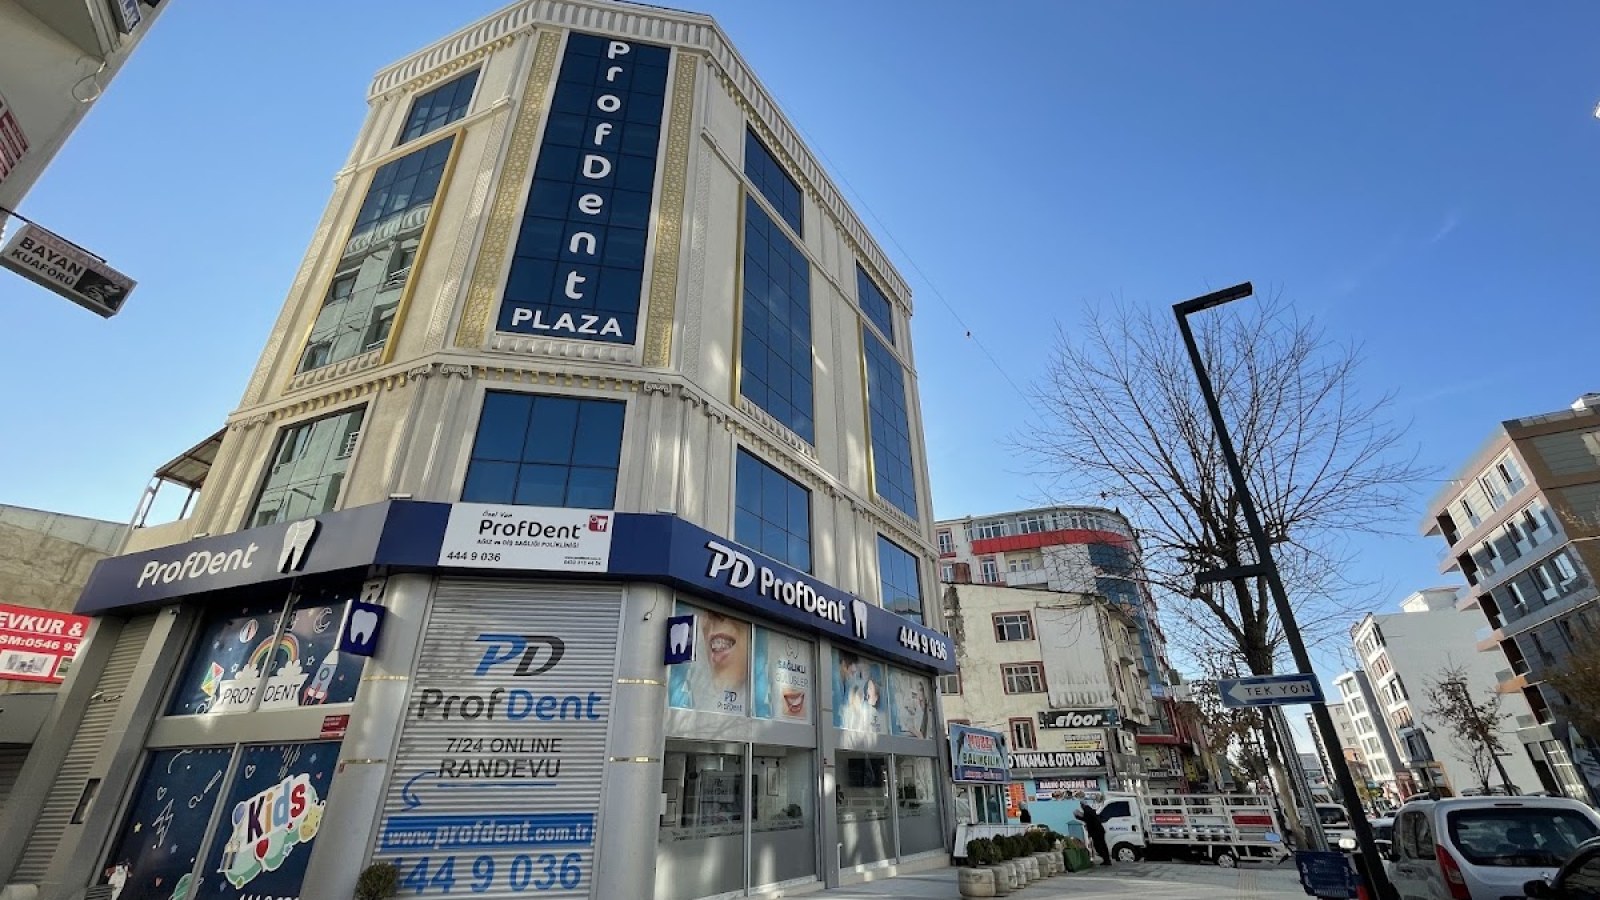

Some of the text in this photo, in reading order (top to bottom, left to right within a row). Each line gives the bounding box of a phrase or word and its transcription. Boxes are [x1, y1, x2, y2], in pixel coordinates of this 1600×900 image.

[565, 41, 630, 300] ProfDent
[19, 236, 83, 276] BAYAN
[511, 307, 623, 337] PLAZA
[479, 519, 581, 539] ProfDent
[136, 542, 259, 589] ProfDent
[446, 551, 501, 562] 444 9 036
[760, 566, 847, 625] ProfDent
[68, 622, 83, 637] &
[899, 625, 948, 661] 444 9 036
[473, 633, 565, 677] PD
[221, 683, 301, 705] PROF DENT
[416, 687, 602, 722] ProfDent
[1244, 686, 1273, 697] TEK
[447, 738, 562, 753] 7/24 ONLINE
[1013, 753, 1048, 767] YIKAMA
[1048, 753, 1056, 767] &
[1056, 753, 1074, 767] OTO
[1075, 752, 1100, 766] PARK
[438, 759, 561, 779] RANDEVU
[247, 781, 306, 844] Kids
[387, 820, 591, 850] www.profdent.com.tr
[470, 854, 495, 893] 9
[509, 852, 583, 892] 036
